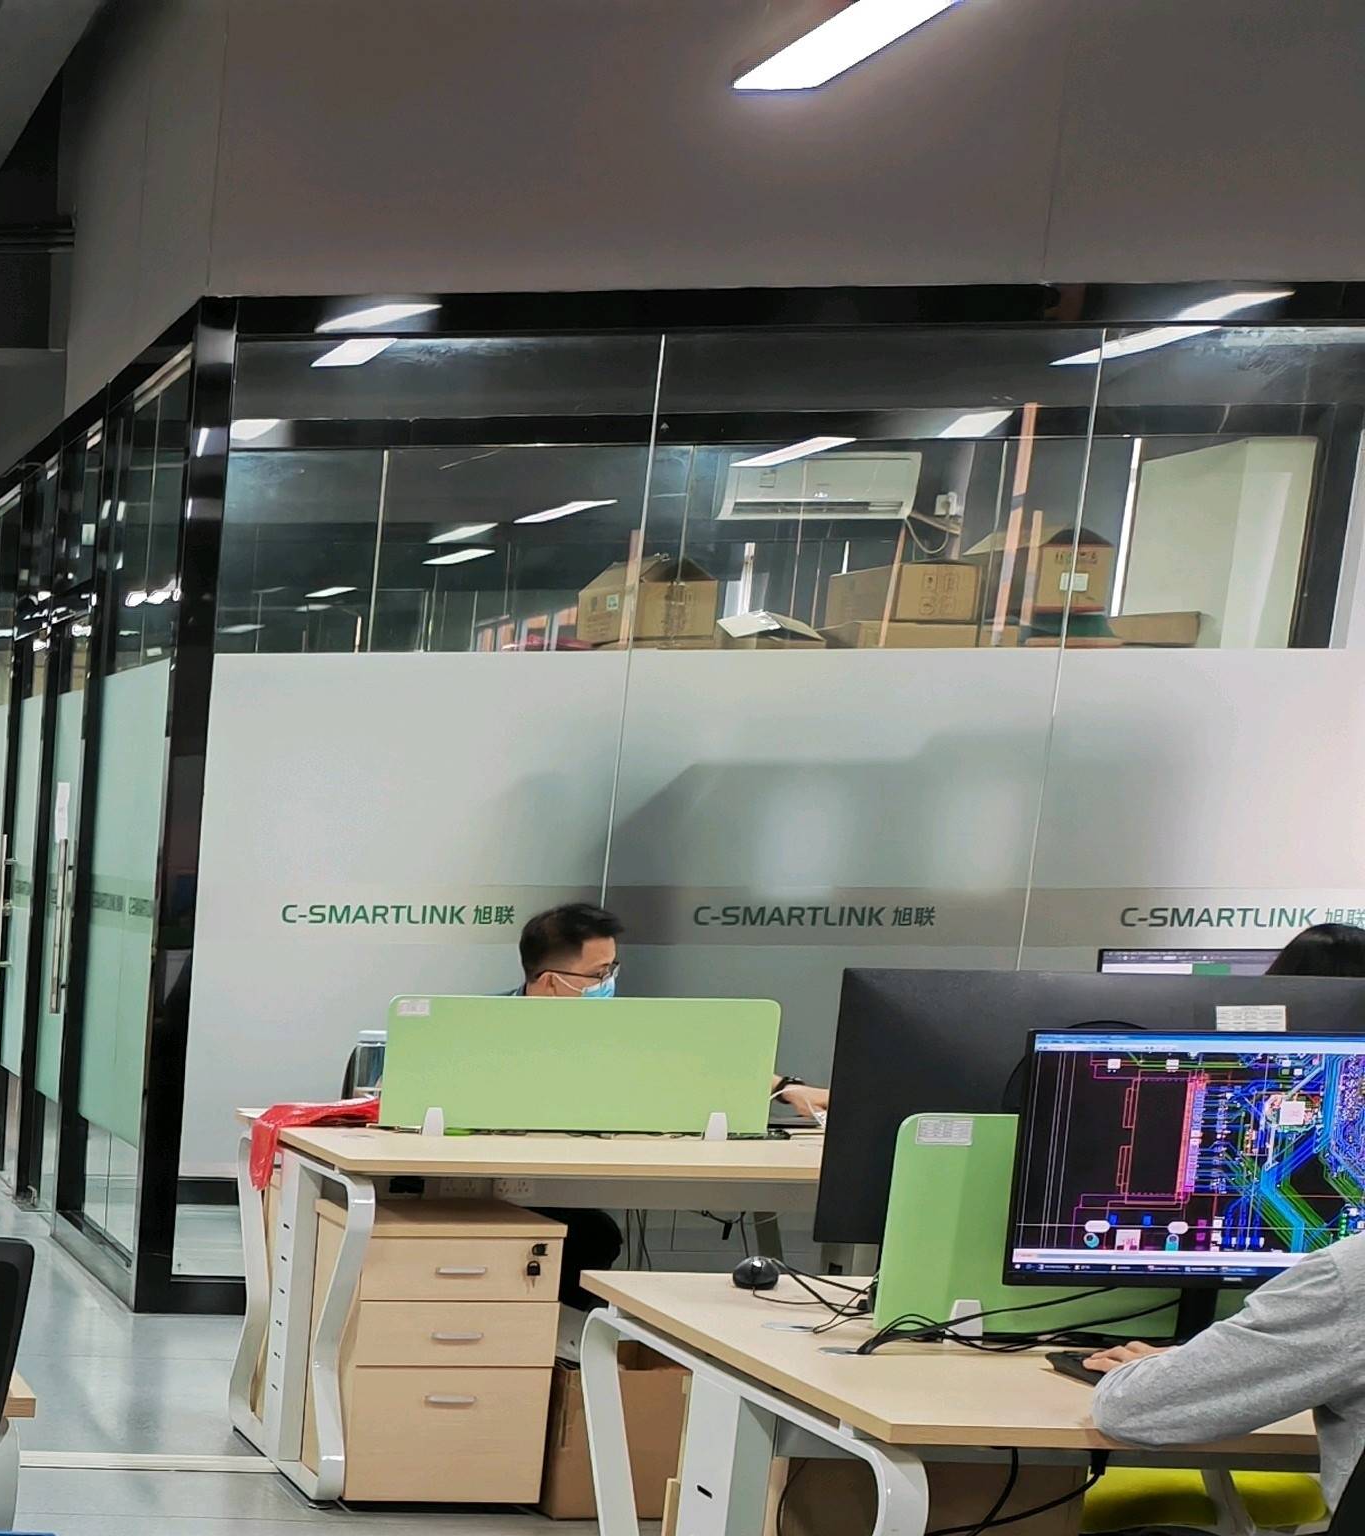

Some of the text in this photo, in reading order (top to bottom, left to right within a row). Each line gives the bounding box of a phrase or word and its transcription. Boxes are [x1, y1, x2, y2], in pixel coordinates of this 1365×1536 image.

[281, 904, 516, 925] C-SMARTLINK 旭联
[693, 905, 937, 927] C-SMARTLINK 旭联
[1120, 907, 1318, 928] C-SMARTLINK
